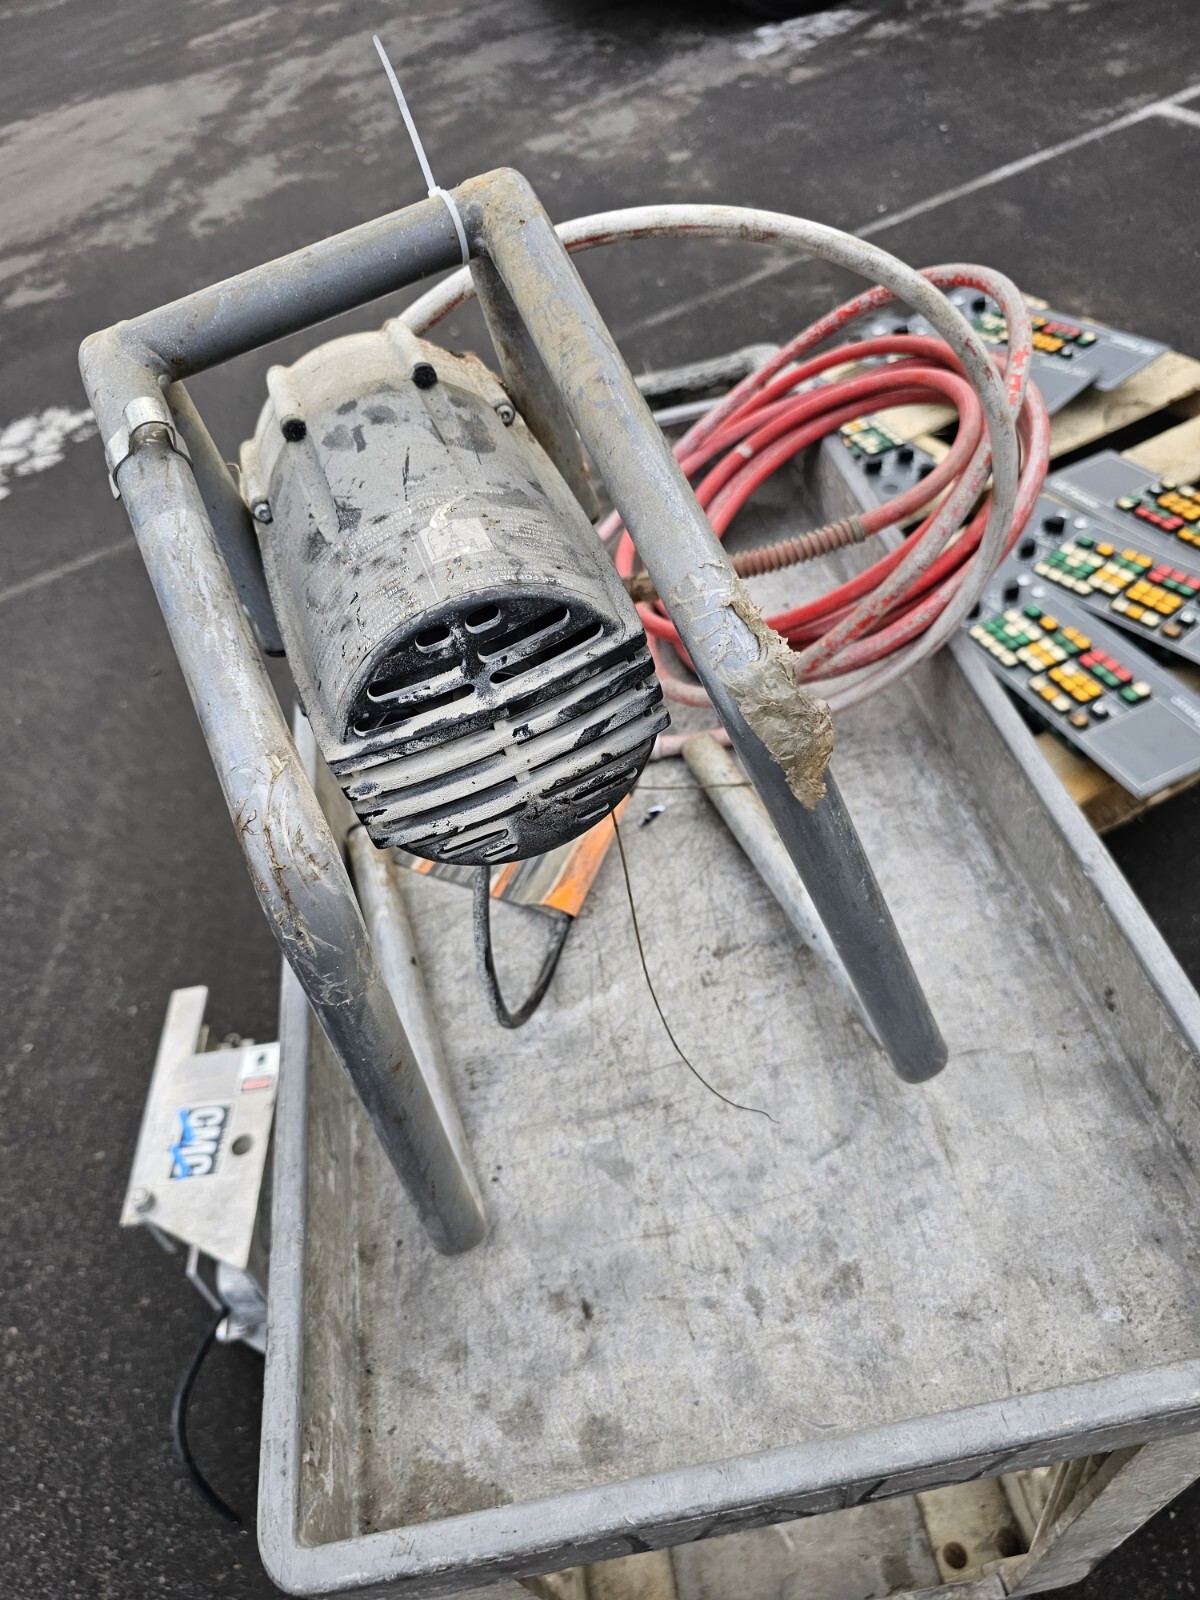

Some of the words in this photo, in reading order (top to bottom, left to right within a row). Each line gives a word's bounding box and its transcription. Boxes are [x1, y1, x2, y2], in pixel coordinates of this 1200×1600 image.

[461, 577, 484, 590] USE
[486, 573, 515, 583] NEXT
[174, 1107, 225, 1178] CMC
